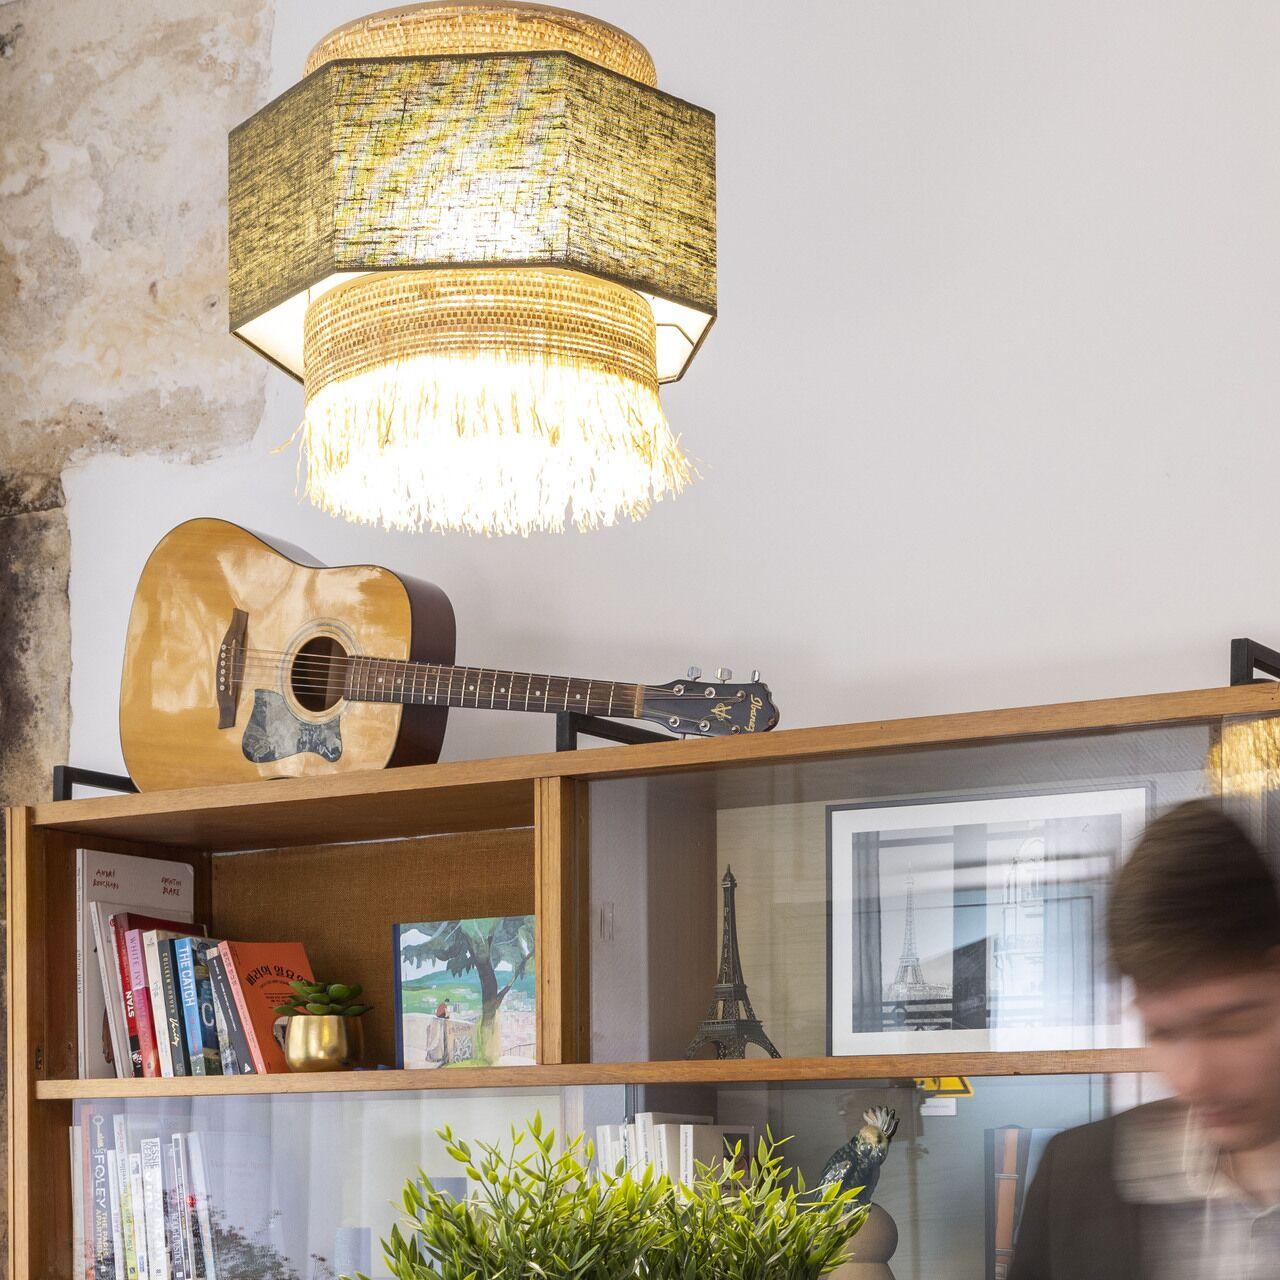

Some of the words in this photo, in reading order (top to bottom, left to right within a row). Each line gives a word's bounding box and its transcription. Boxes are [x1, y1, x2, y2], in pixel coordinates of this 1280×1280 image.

[129, 937, 140, 968] WHITE
[178, 945, 189, 968] THE
[133, 969, 143, 987] IVY
[162, 952, 170, 983] COLLEEN
[181, 969, 195, 1007] CATCH
[125, 990, 136, 1018] STAN
[143, 1141, 152, 1169] KEANE
[151, 1141, 160, 1169] JESSIE
[94, 1154, 107, 1209] FOLEY
[95, 1209, 104, 1262] APARTMENT
